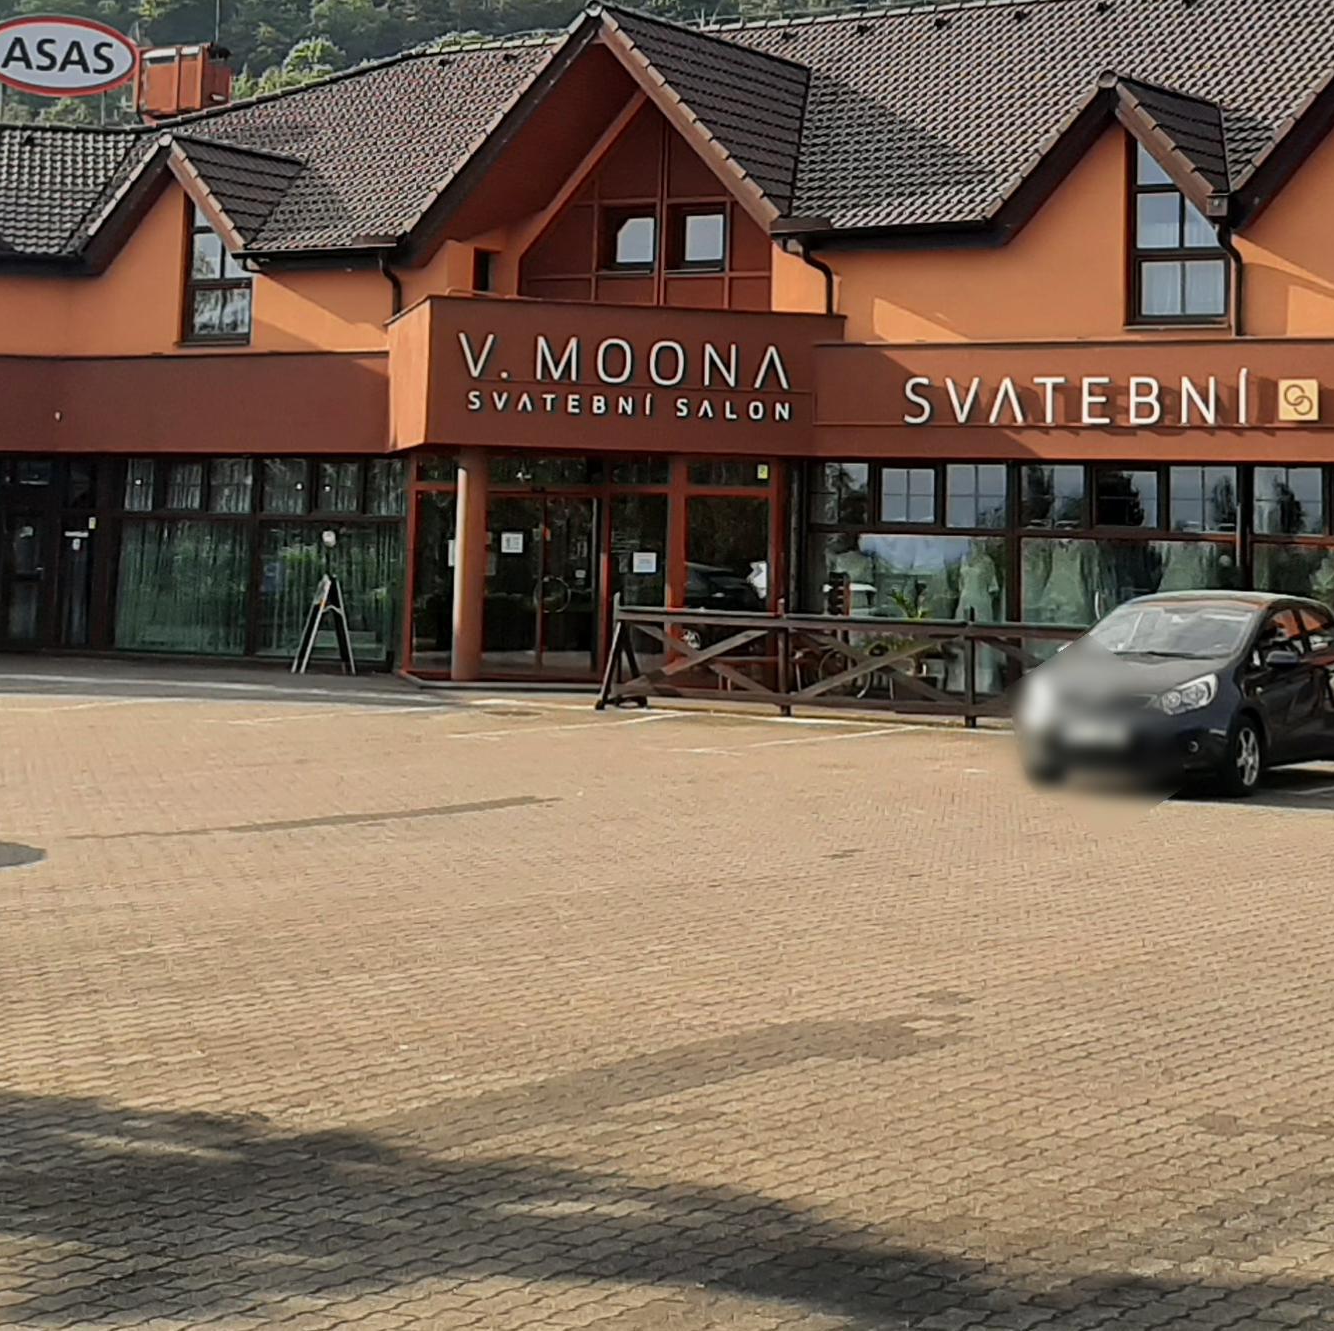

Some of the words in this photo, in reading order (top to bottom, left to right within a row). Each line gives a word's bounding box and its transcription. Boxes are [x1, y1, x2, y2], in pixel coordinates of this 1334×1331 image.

[0, 35, 115, 75] ASAS
[457, 331, 510, 380] V.
[534, 335, 790, 391] MOONA
[467, 390, 653, 417] SVATEBNÍ
[675, 397, 791, 421] SALON
[903, 367, 1249, 426] SVATEBNÍ
